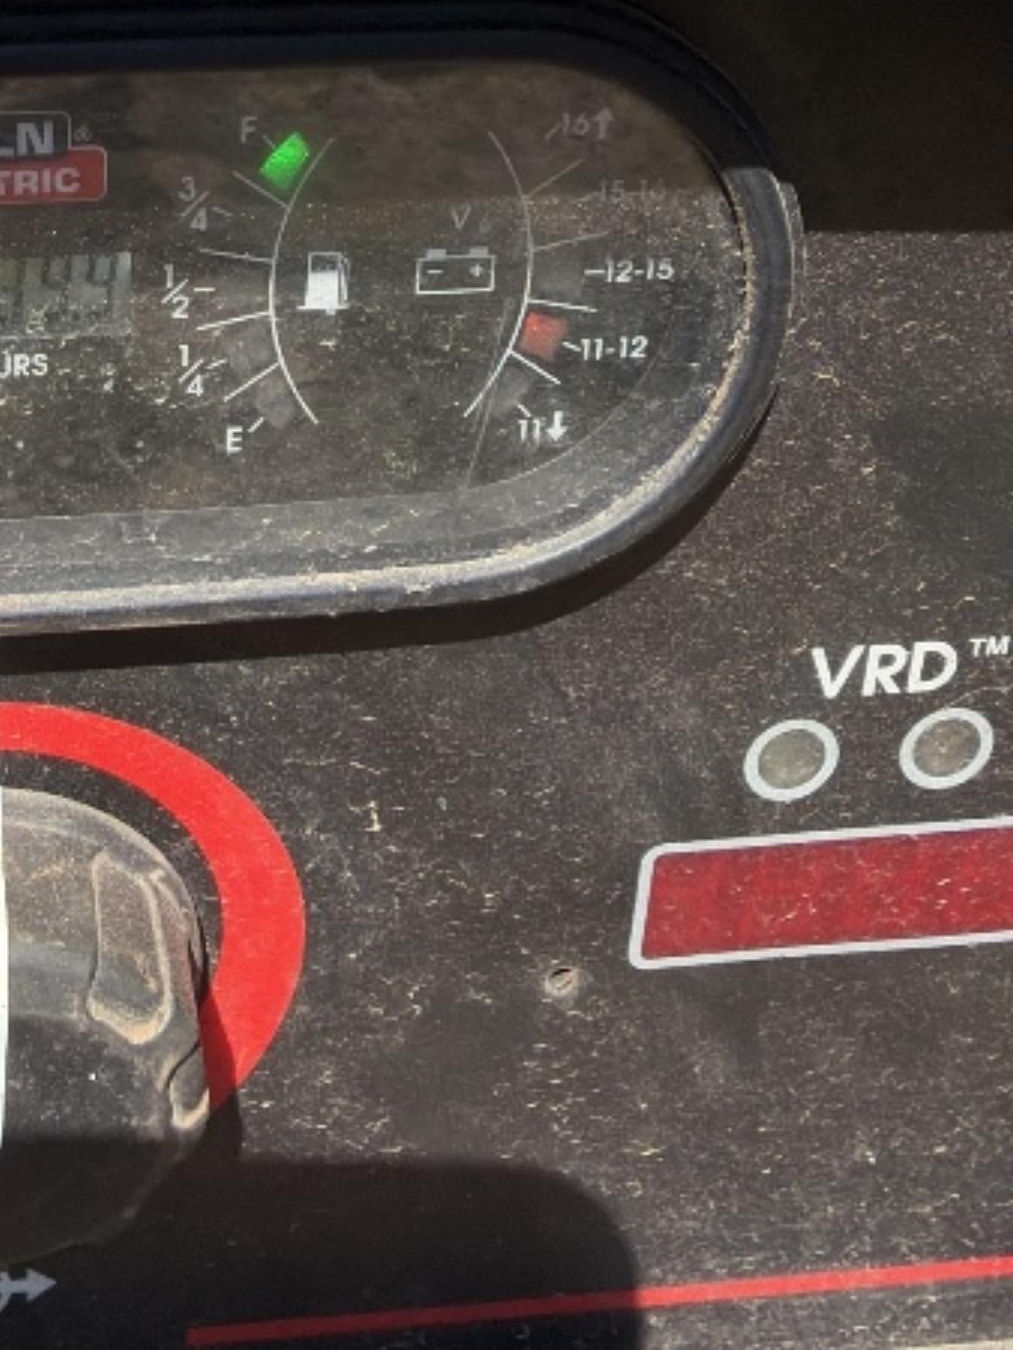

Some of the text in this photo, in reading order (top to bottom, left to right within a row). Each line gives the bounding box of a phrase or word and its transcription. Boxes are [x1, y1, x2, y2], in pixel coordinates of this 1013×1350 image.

[240, 116, 258, 143] F
[451, 204, 472, 231] V
[605, 258, 675, 284] 12-15
[580, 335, 649, 361] 11-12
[225, 425, 243, 454] E
[811, 641, 958, 700] VRD
